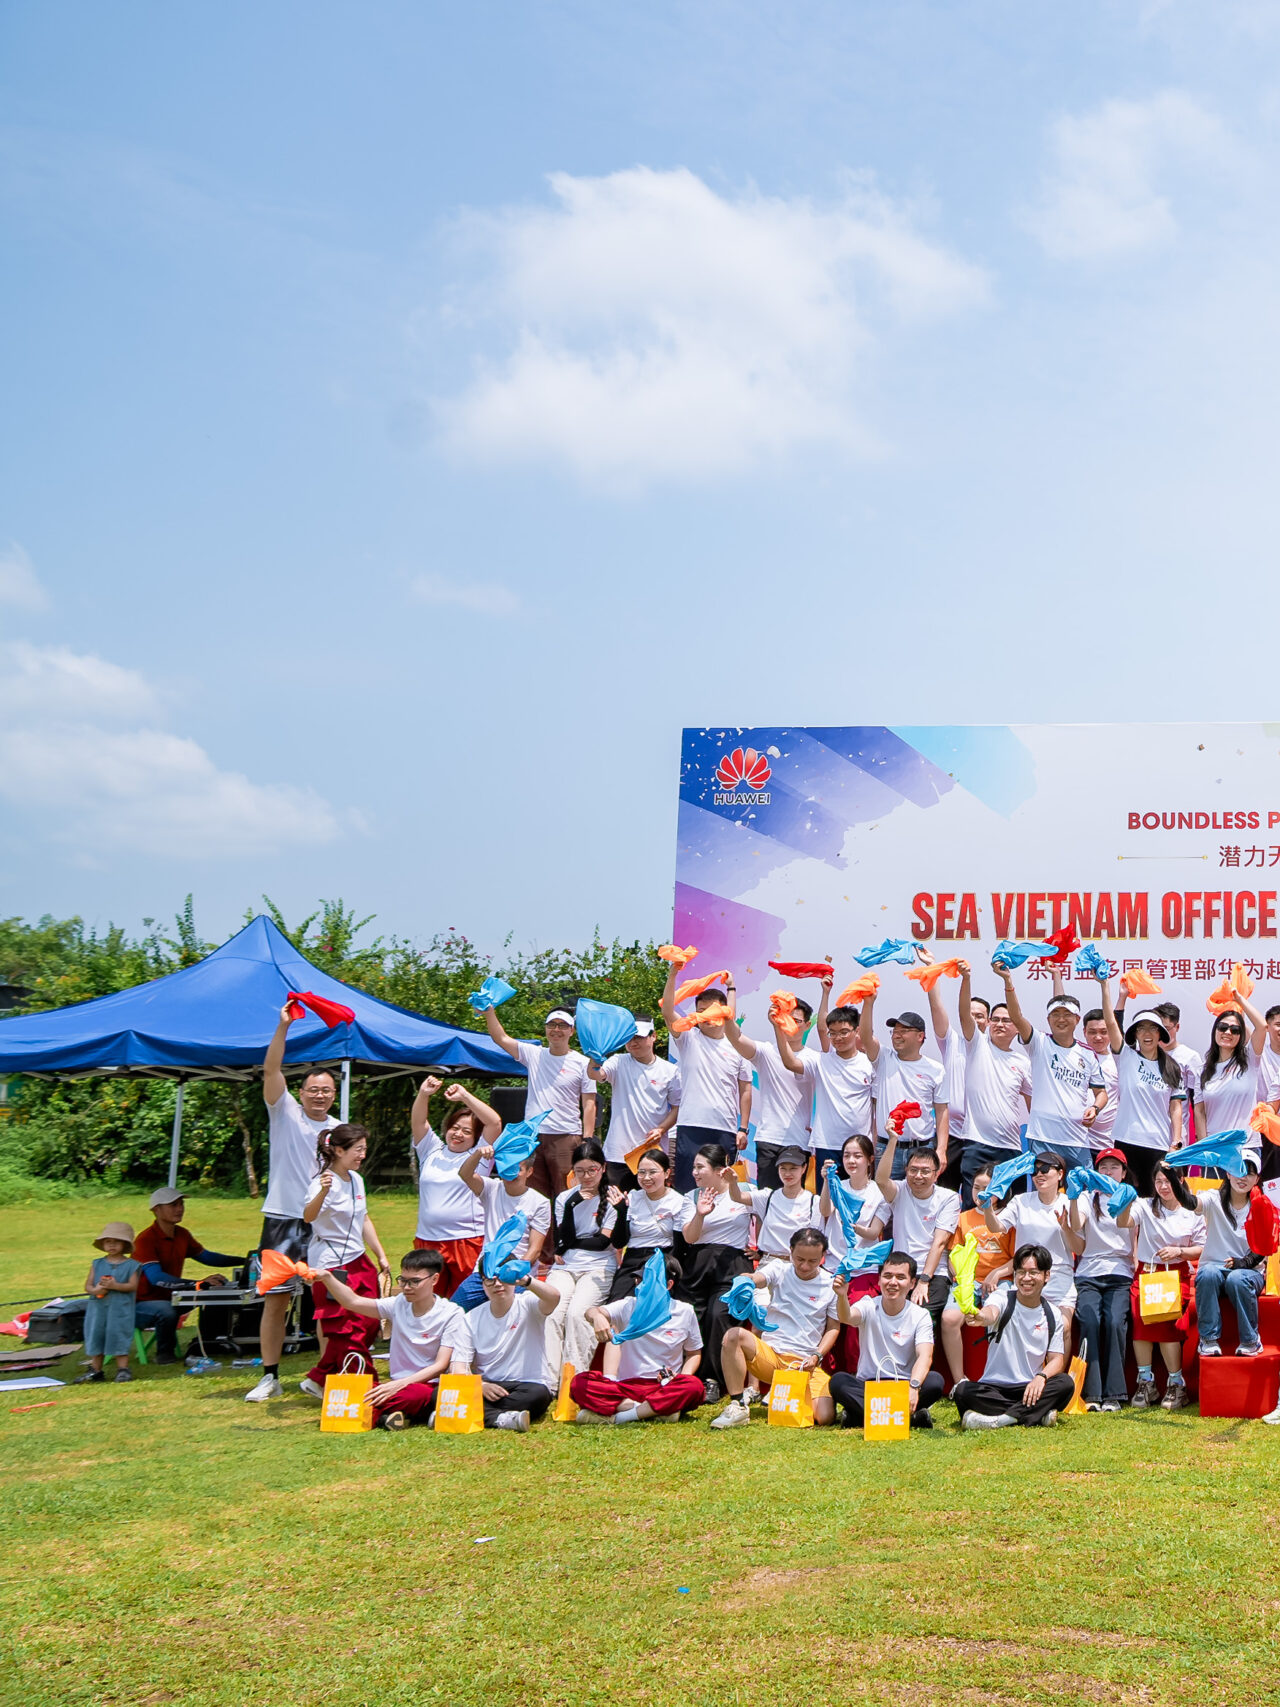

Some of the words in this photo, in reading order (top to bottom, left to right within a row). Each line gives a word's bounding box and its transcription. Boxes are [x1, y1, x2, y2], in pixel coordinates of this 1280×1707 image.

[714, 793, 771, 805] HUAWEI
[1128, 812, 1260, 830] BOUNDLESS
[911, 892, 981, 941] SEA
[990, 892, 1149, 941] VIETNAM
[1161, 890, 1278, 939] OFFICE
[329, 1389, 349, 1403] OH!
[440, 1389, 459, 1404] OH!
[774, 1383, 791, 1398] OH!
[326, 1403, 360, 1418] SOME
[439, 1403, 467, 1418] SOME
[772, 1398, 799, 1413] SOME
[870, 1397, 891, 1412] OH!
[870, 1411, 905, 1425] SOME
